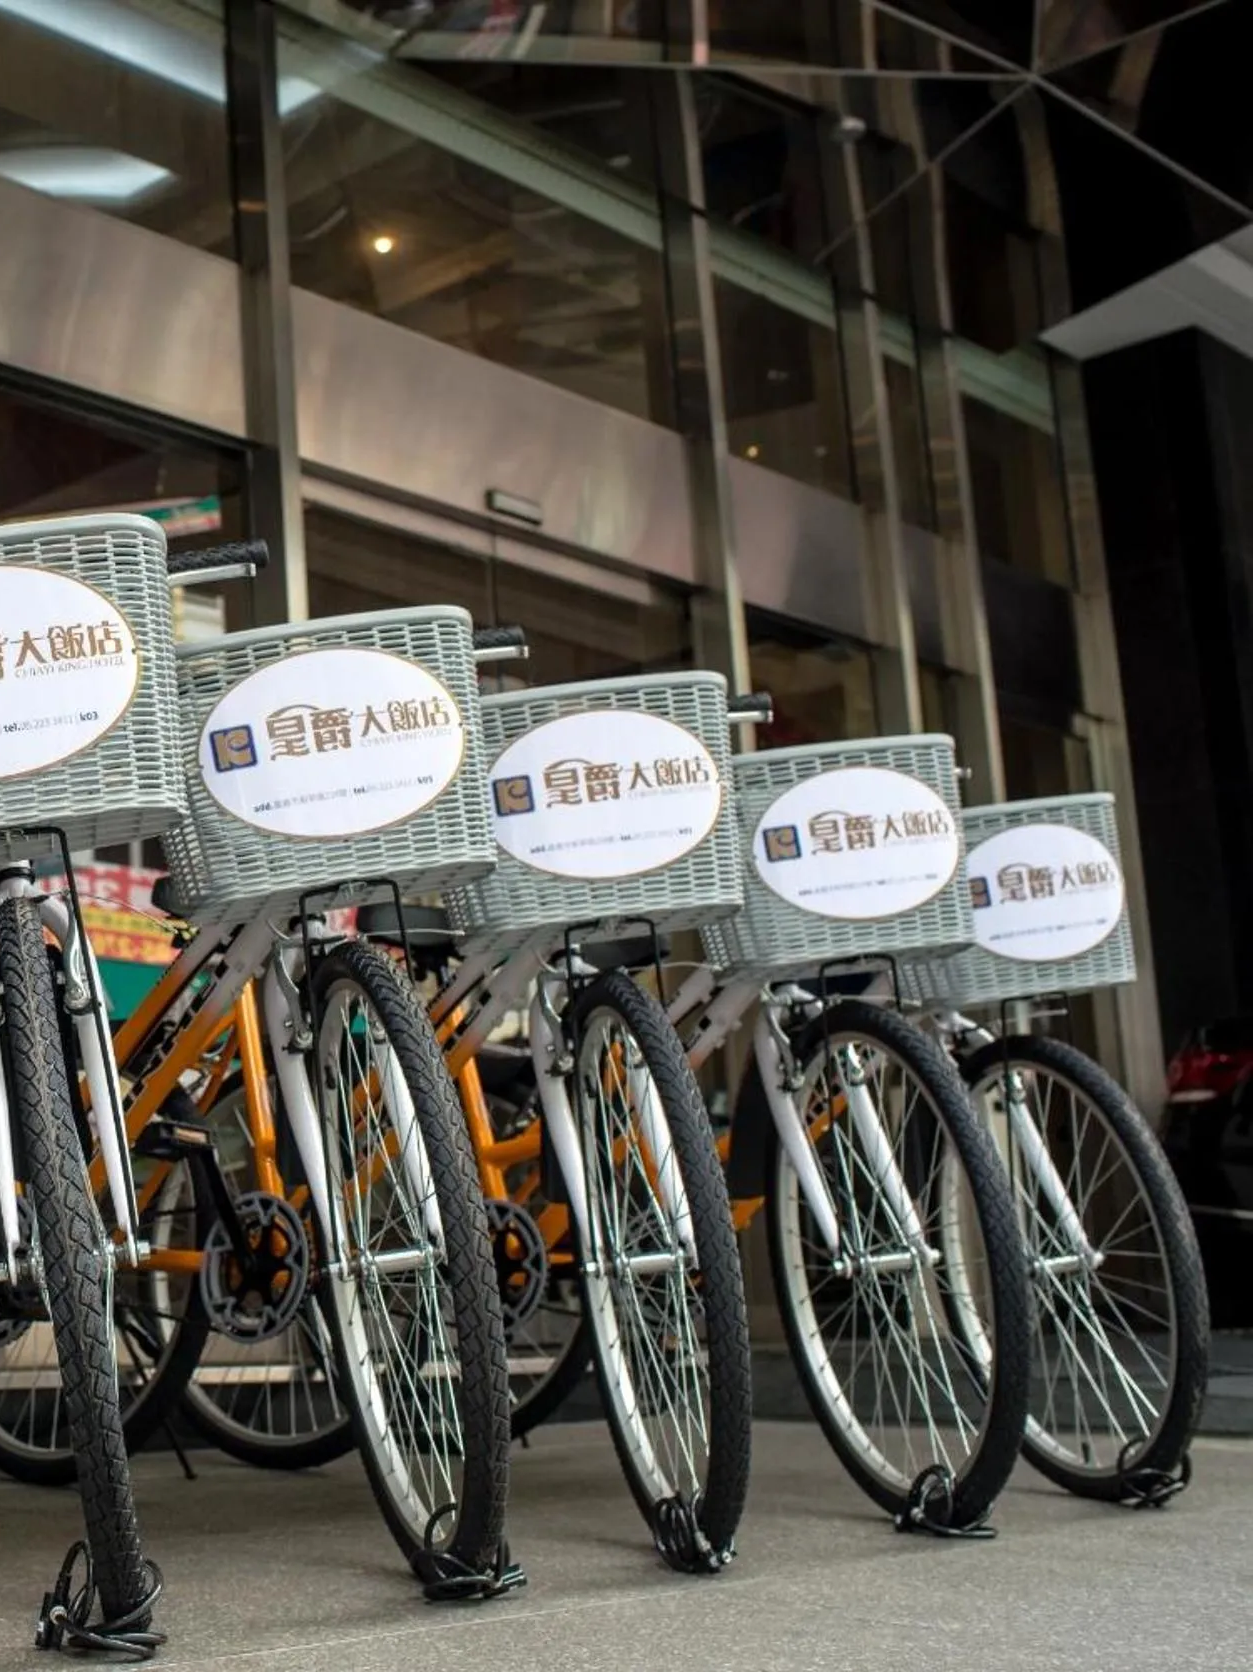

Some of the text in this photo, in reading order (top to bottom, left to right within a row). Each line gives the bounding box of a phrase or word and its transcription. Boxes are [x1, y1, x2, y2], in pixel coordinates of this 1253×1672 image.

[266, 697, 451, 761] 皇爵大飯店
[543, 756, 710, 808] 皇爵大飯店
